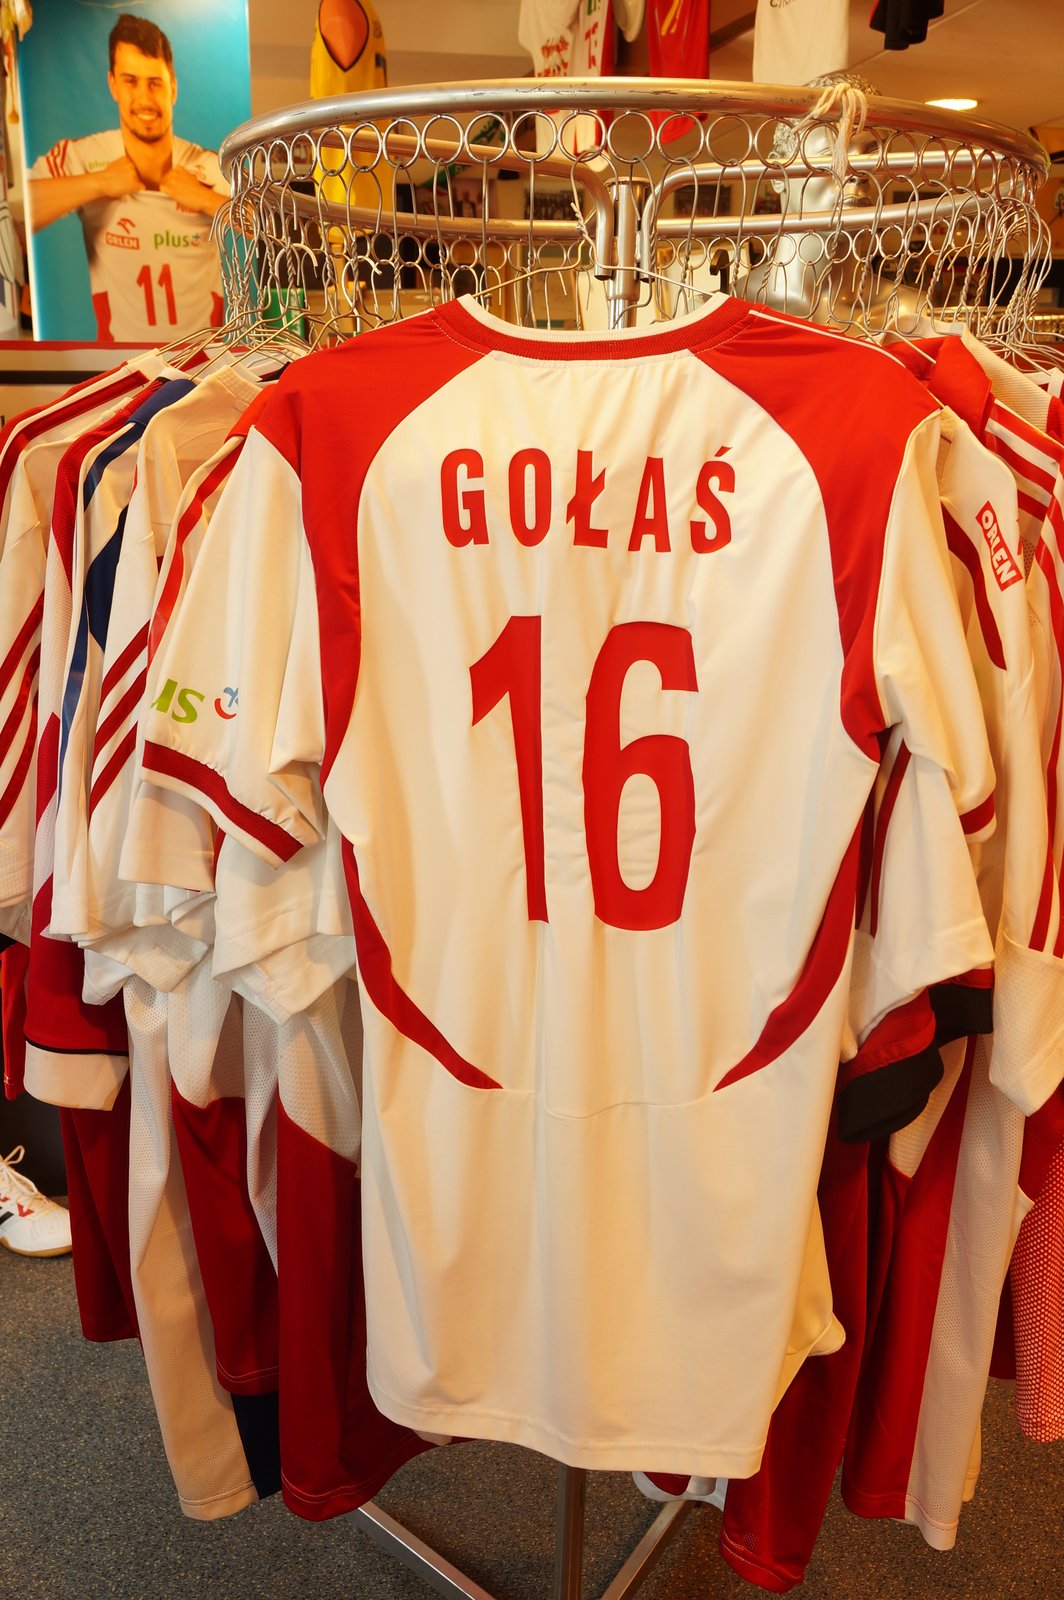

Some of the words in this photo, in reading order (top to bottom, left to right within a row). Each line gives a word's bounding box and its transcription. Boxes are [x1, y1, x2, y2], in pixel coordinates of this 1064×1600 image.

[106, 233, 139, 249] ORLEN
[136, 264, 178, 327] 11
[440, 446, 736, 554] GOŁAŚ
[981, 509, 1018, 585] ORLEN
[469, 615, 700, 932] 16
